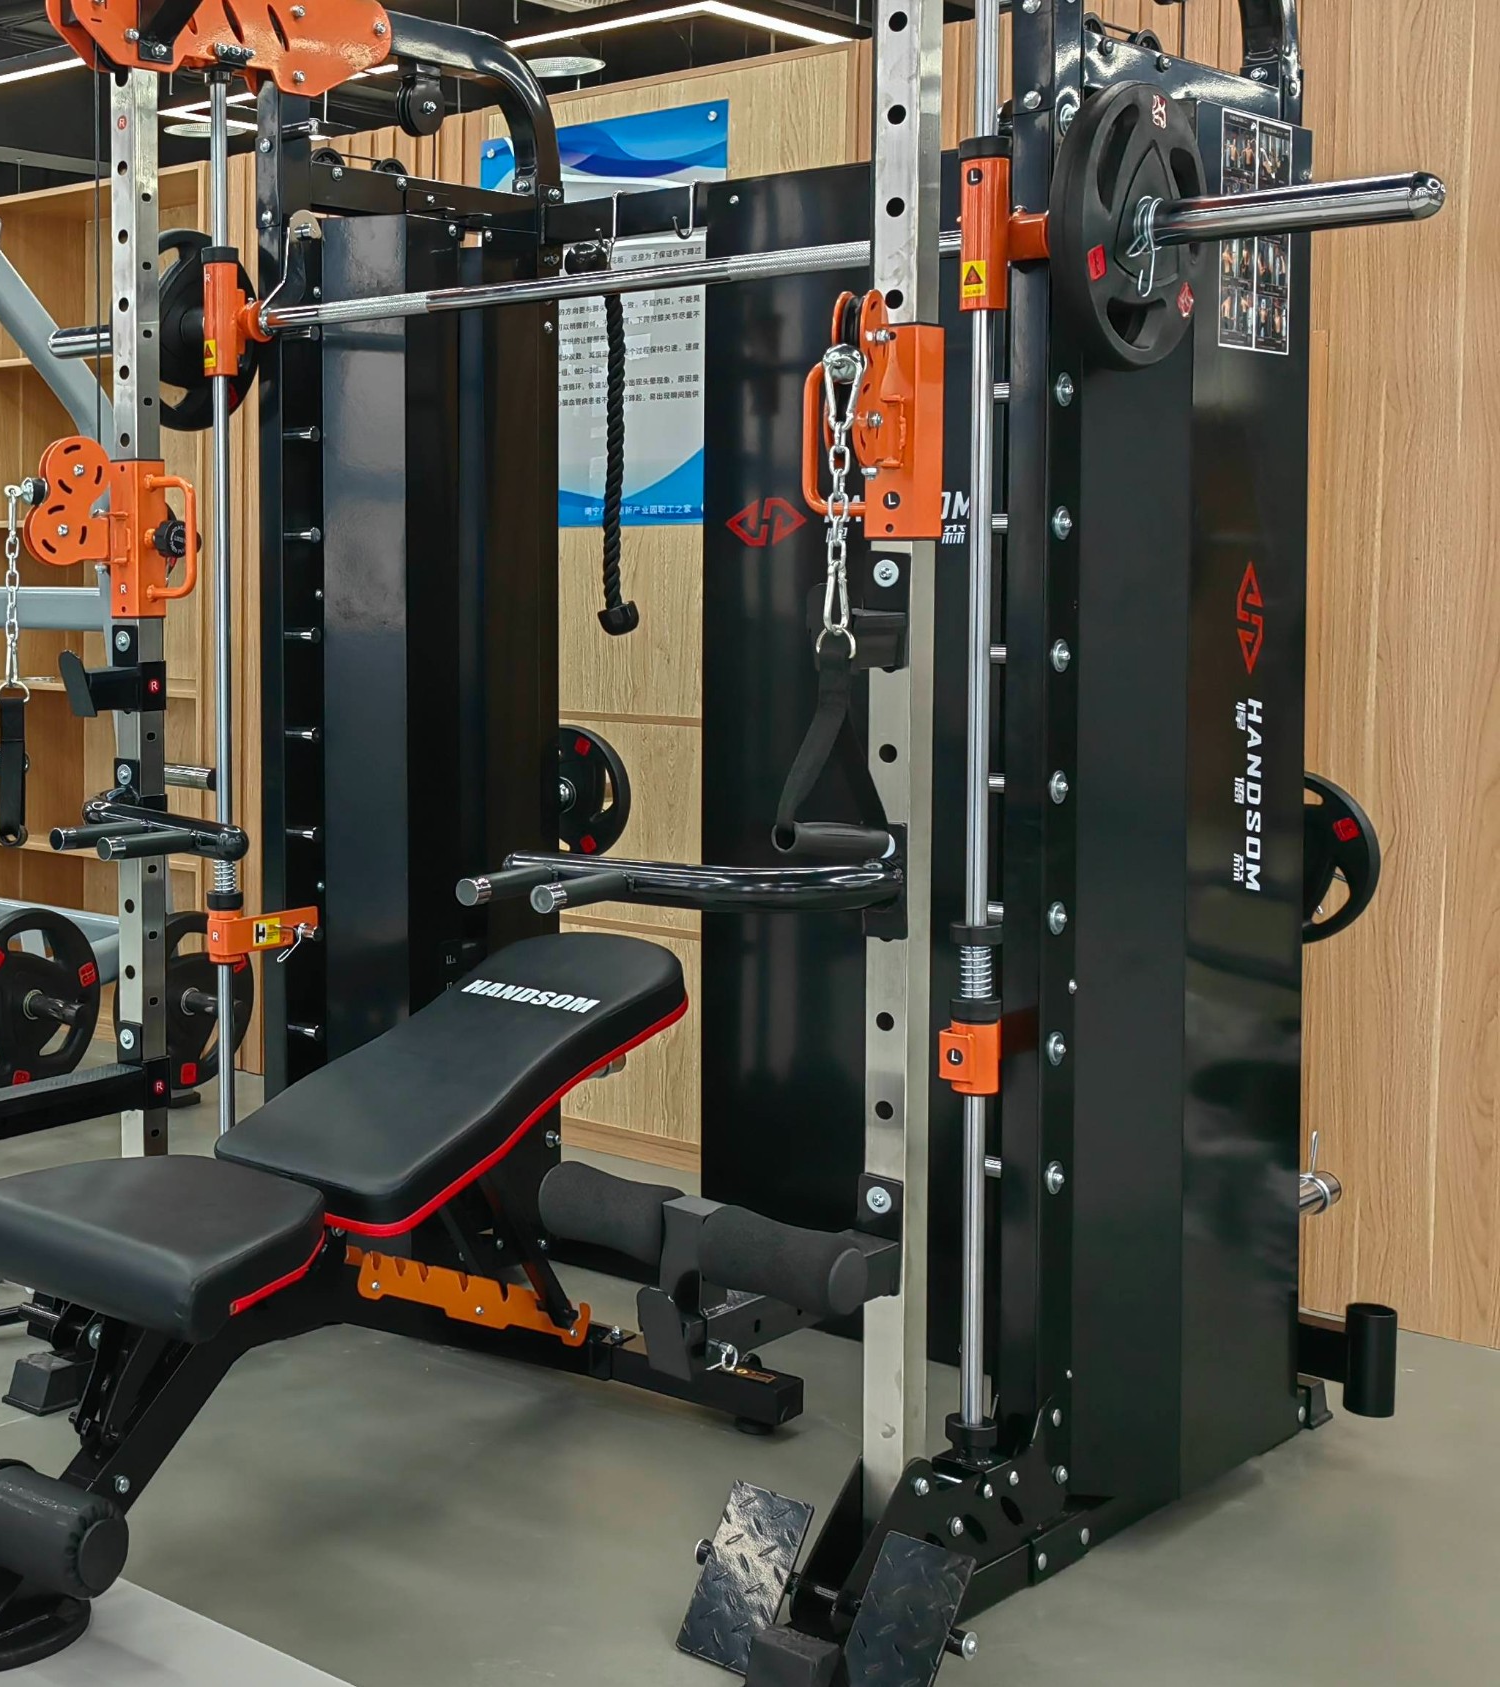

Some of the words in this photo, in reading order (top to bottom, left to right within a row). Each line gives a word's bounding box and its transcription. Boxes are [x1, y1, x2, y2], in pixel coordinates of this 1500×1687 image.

[971, 170, 978, 181] L
[888, 493, 896, 505] L
[120, 584, 127, 594] R
[151, 682, 158, 691] R
[1245, 698, 1263, 892] HANDSOM
[212, 931, 219, 941] R
[461, 978, 600, 1014] HANDSOM
[951, 1049, 959, 1062] L
[156, 1081, 164, 1092] R
